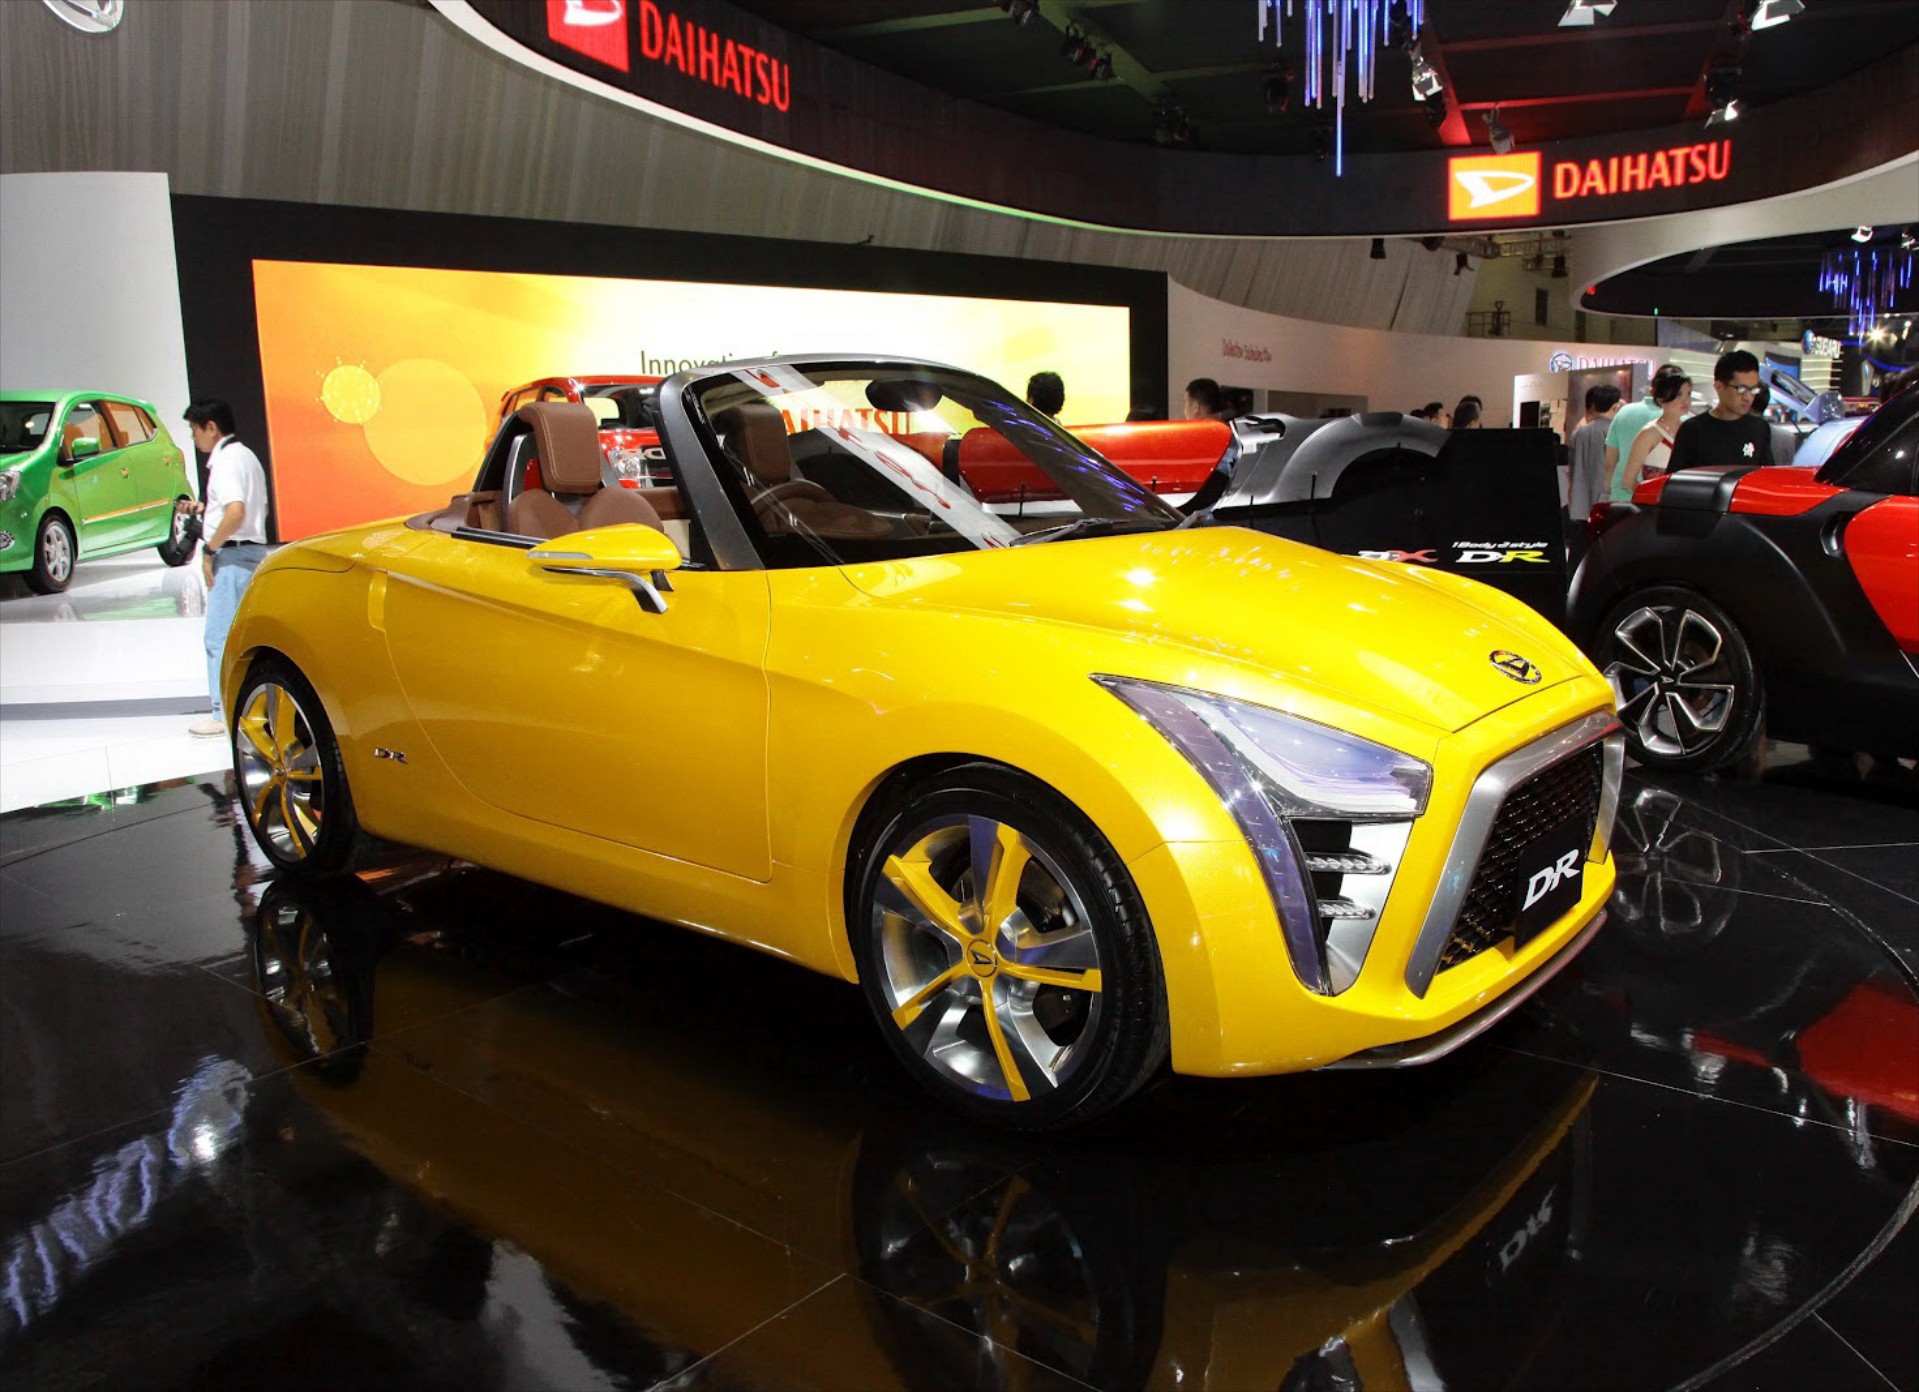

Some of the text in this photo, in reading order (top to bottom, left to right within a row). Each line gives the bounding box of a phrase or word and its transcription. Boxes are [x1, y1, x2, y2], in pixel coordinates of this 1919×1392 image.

[639, 0, 790, 112] DAIHATSU
[1553, 139, 1732, 199] DAIHATSU
[640, 350, 740, 376] Innov
[781, 407, 911, 435] AIHATSU
